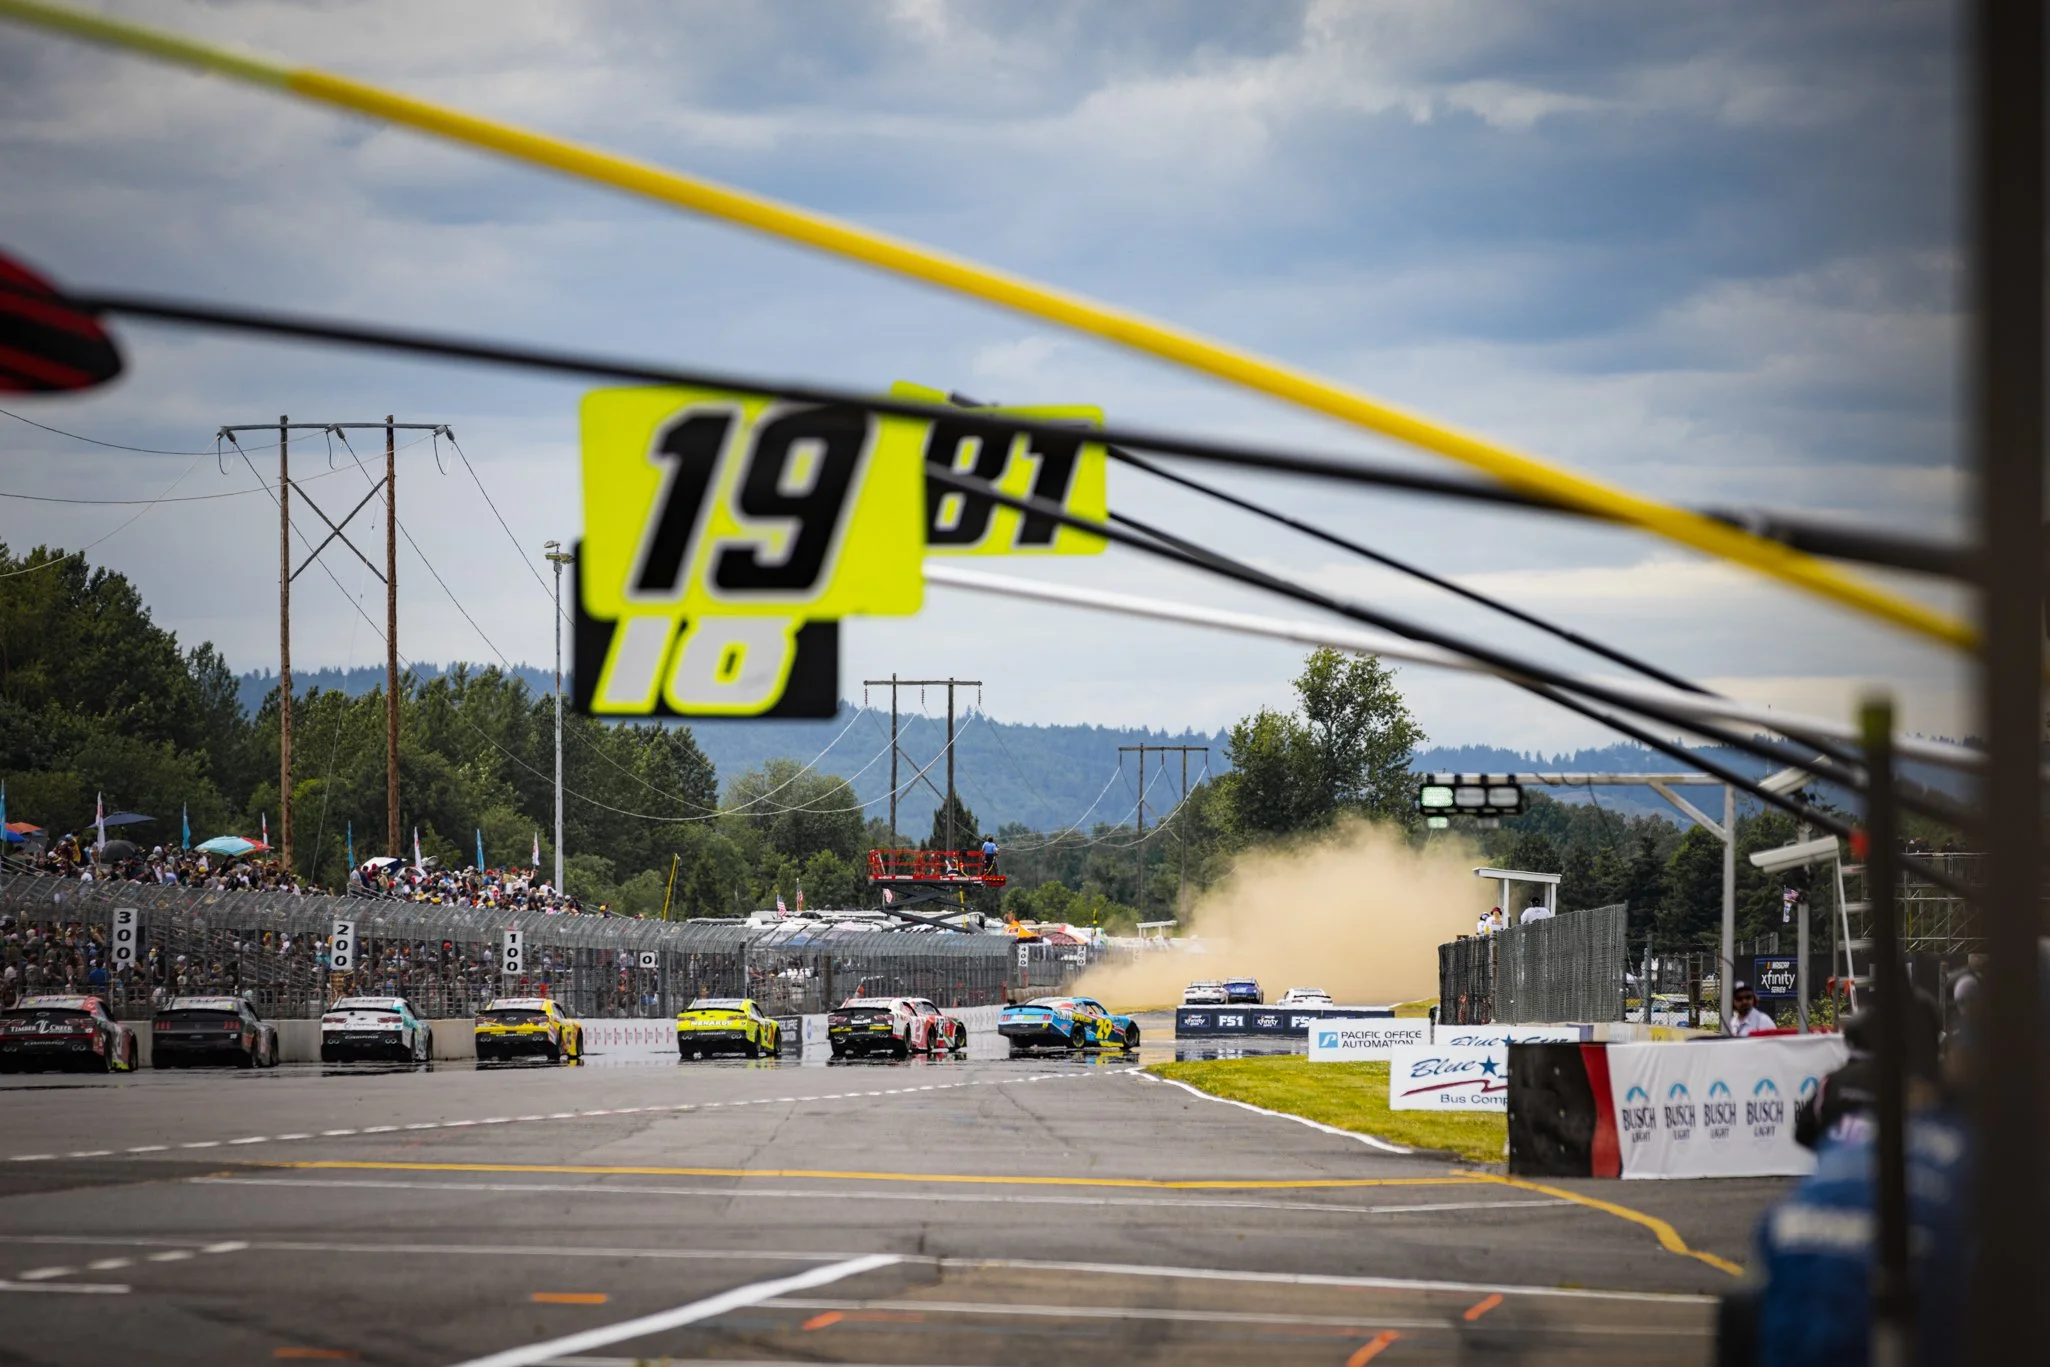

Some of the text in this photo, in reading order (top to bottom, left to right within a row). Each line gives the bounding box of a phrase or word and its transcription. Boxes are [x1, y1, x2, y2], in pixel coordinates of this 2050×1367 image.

[924, 418, 1097, 550] 81
[626, 400, 877, 603] 19
[117, 911, 132, 960] 300
[334, 924, 350, 967] 200
[506, 933, 519, 972] 100
[642, 955, 653, 965] 0
[1761, 970, 1796, 990] xfinity
[1770, 986, 1787, 994] SERIES
[10, 1024, 37, 1033] TIMBER
[49, 1024, 74, 1034] CREEK
[1095, 1017, 1113, 1040] 29
[1218, 1015, 1245, 1027] FS1
[1340, 1030, 1423, 1040] PACIFIC OFFICE
[1410, 1058, 1479, 1078] Blue
[1440, 1094, 1467, 1104] Bus
[1621, 1107, 1656, 1131] BUSCH
[1664, 1104, 1696, 1129] BUSCH
[1704, 1102, 1737, 1126] BUSCH
[1746, 1100, 1784, 1126] BUSCH
[1632, 1131, 1651, 1143] LIGHT
[1672, 1129, 1691, 1140] LIGHT
[1710, 1127, 1730, 1139] LIGHT
[1754, 1125, 1776, 1137] LIGHT
